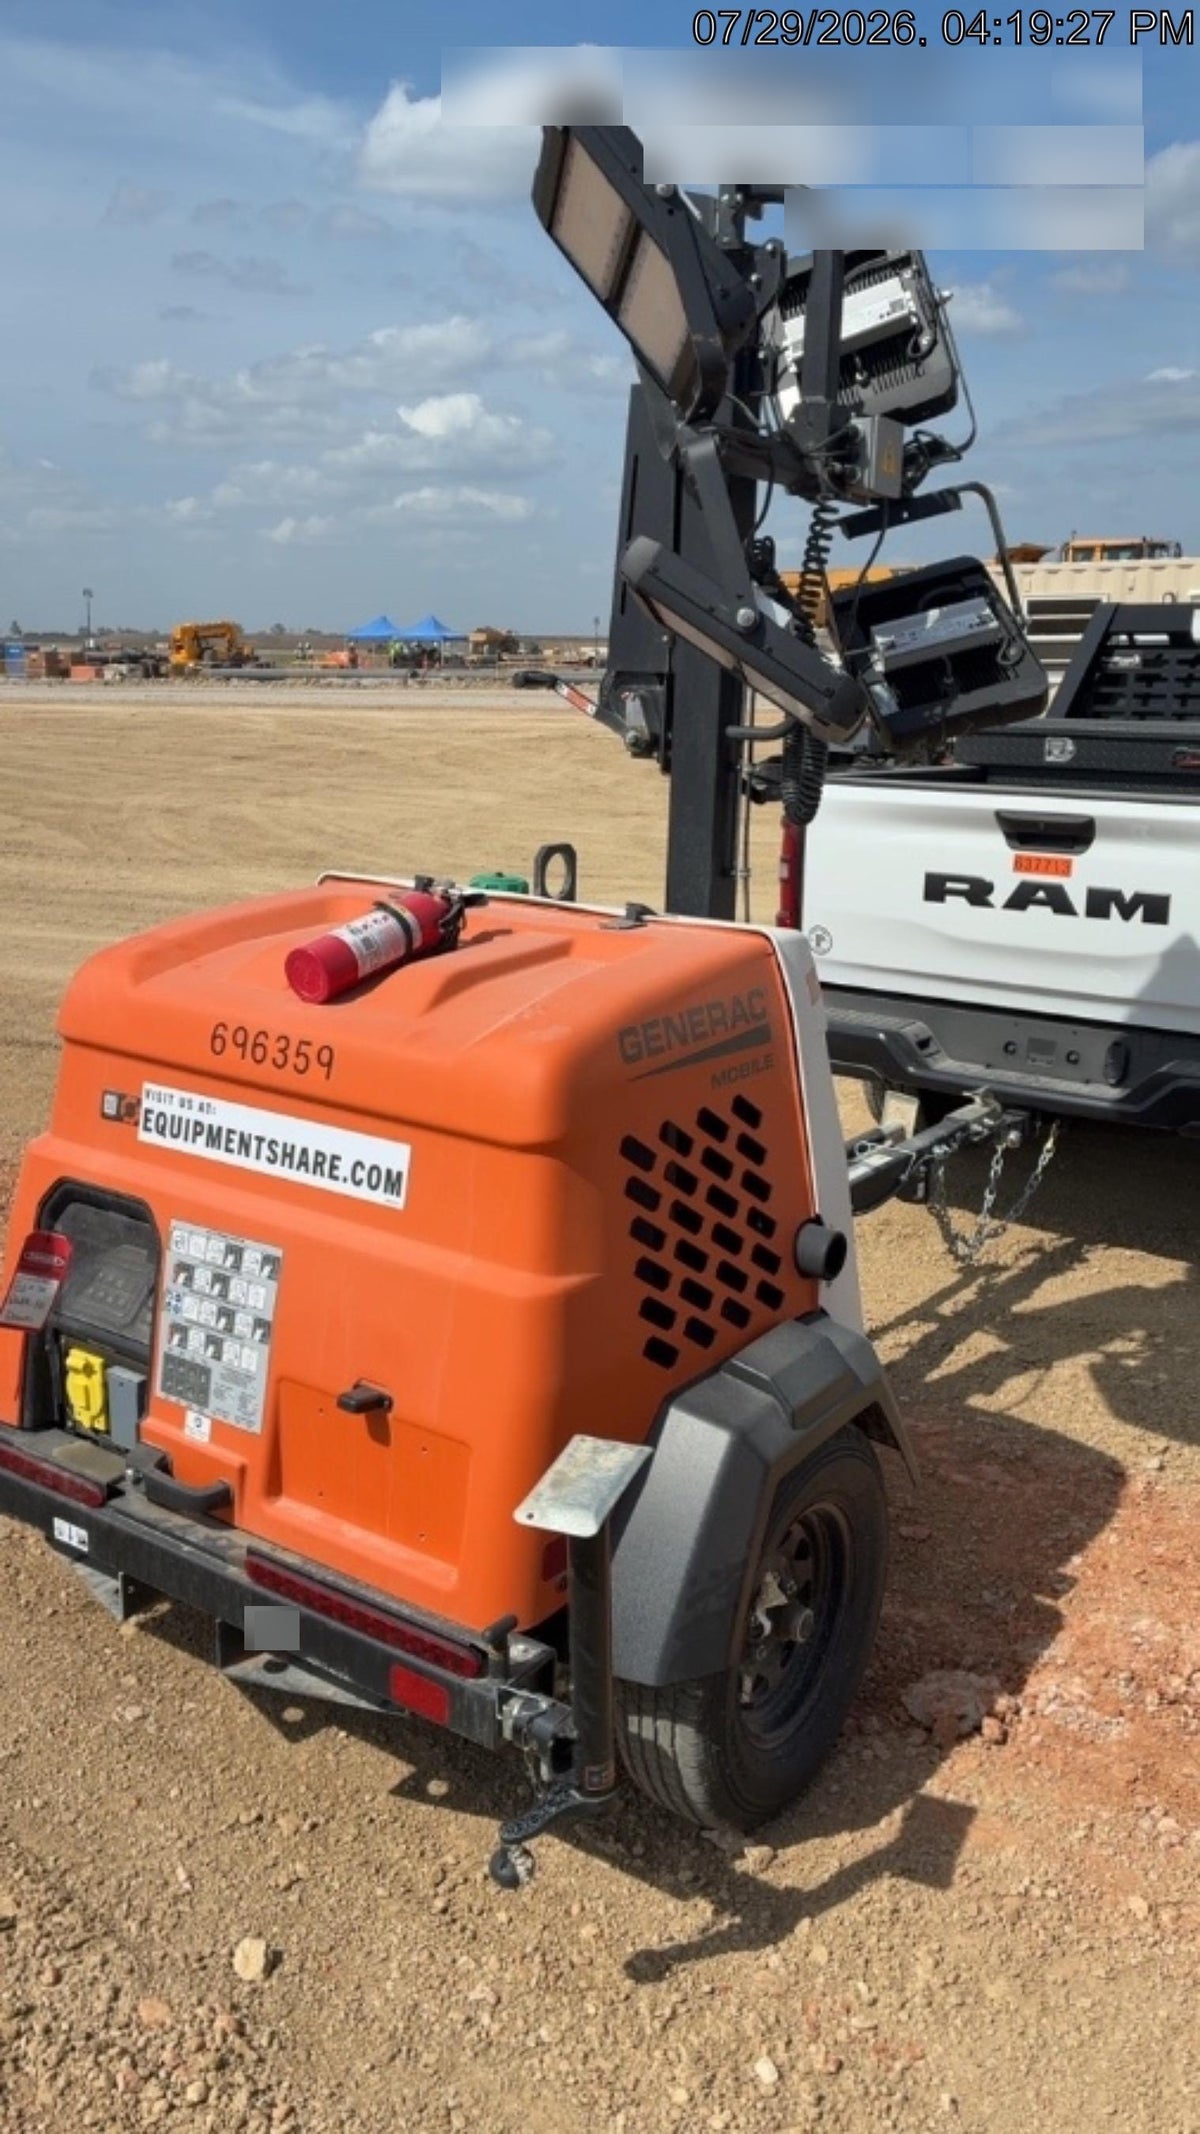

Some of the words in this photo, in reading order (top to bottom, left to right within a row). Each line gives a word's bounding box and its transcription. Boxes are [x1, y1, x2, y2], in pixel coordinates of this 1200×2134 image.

[923, 871, 1172, 925] RAM
[210, 1021, 334, 1081] 696359
[617, 985, 768, 1065] GENERAC
[710, 1053, 775, 1090] MOBILE
[142, 1107, 404, 1198] EQUIPMENTSHARE.COM
